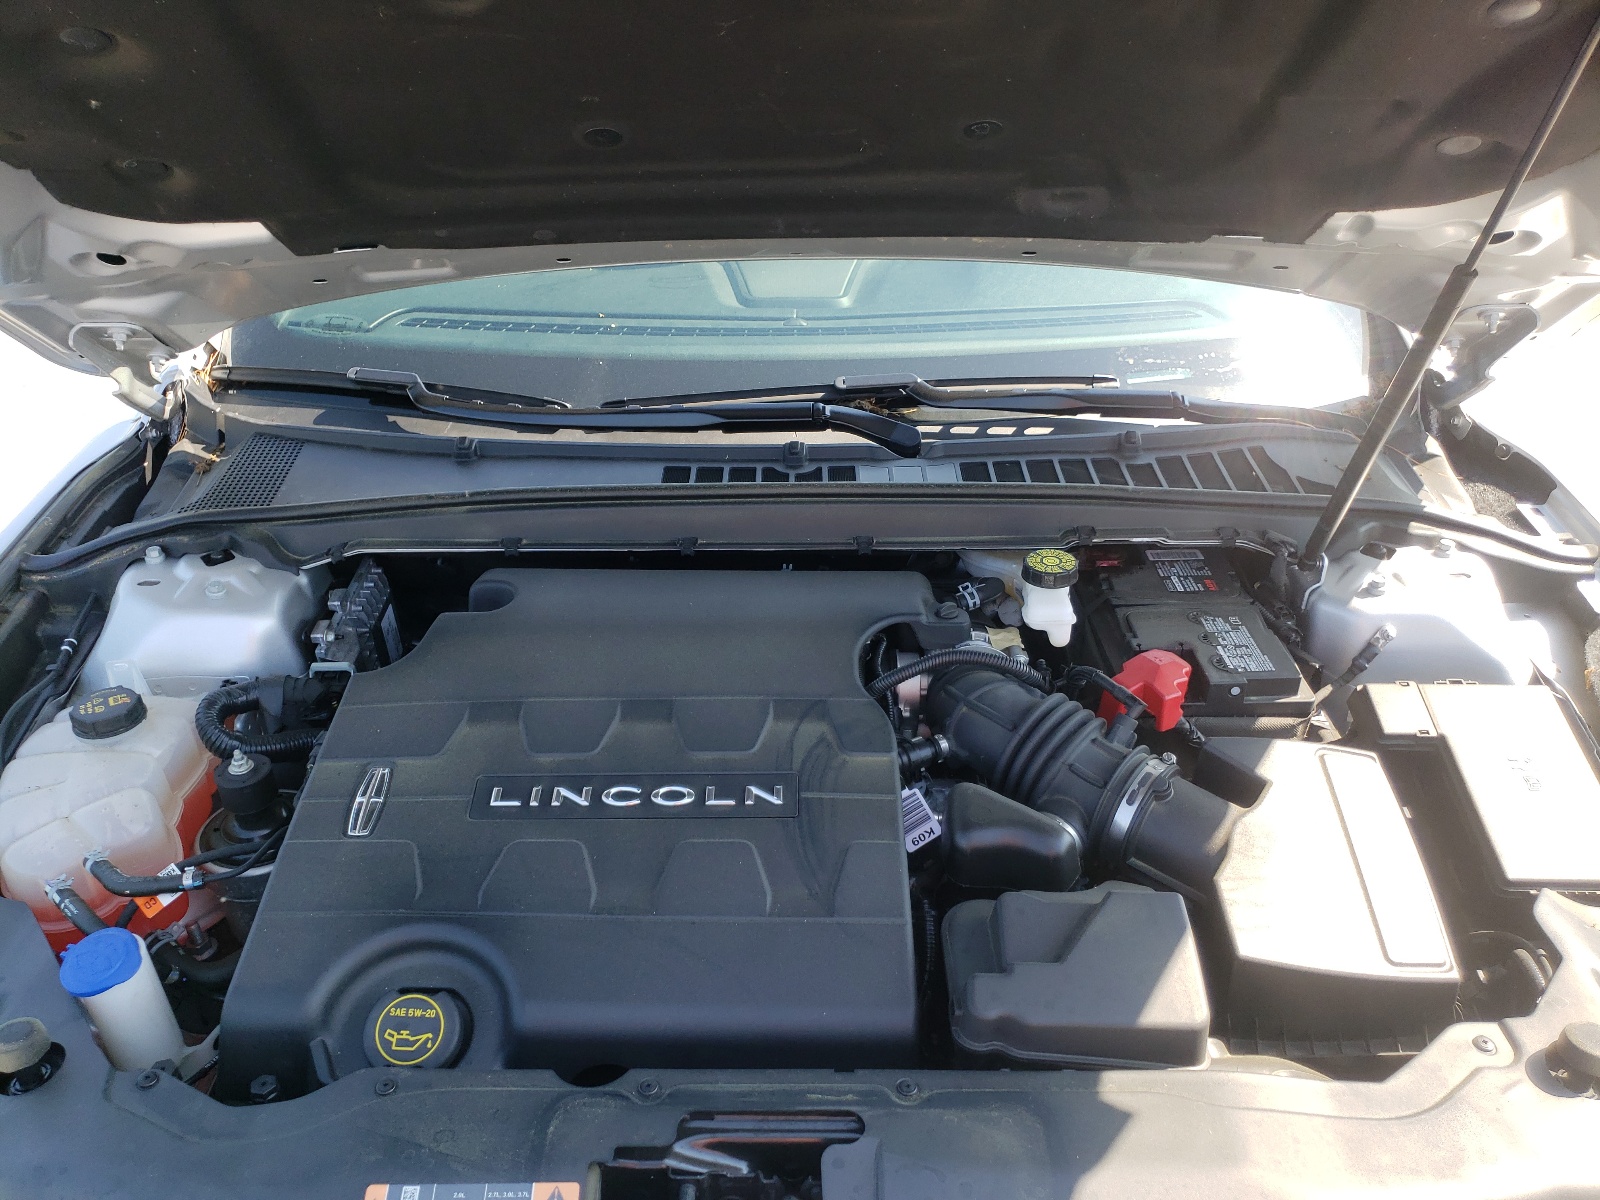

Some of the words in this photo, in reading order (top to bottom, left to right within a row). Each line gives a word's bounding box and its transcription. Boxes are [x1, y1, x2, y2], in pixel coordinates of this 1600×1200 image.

[490, 784, 783, 806] LINCOLN
[911, 827, 936, 846] K09
[144, 897, 157, 909] CD
[389, 1007, 406, 1016] SAE
[408, 1008, 436, 1018] 5W-20
